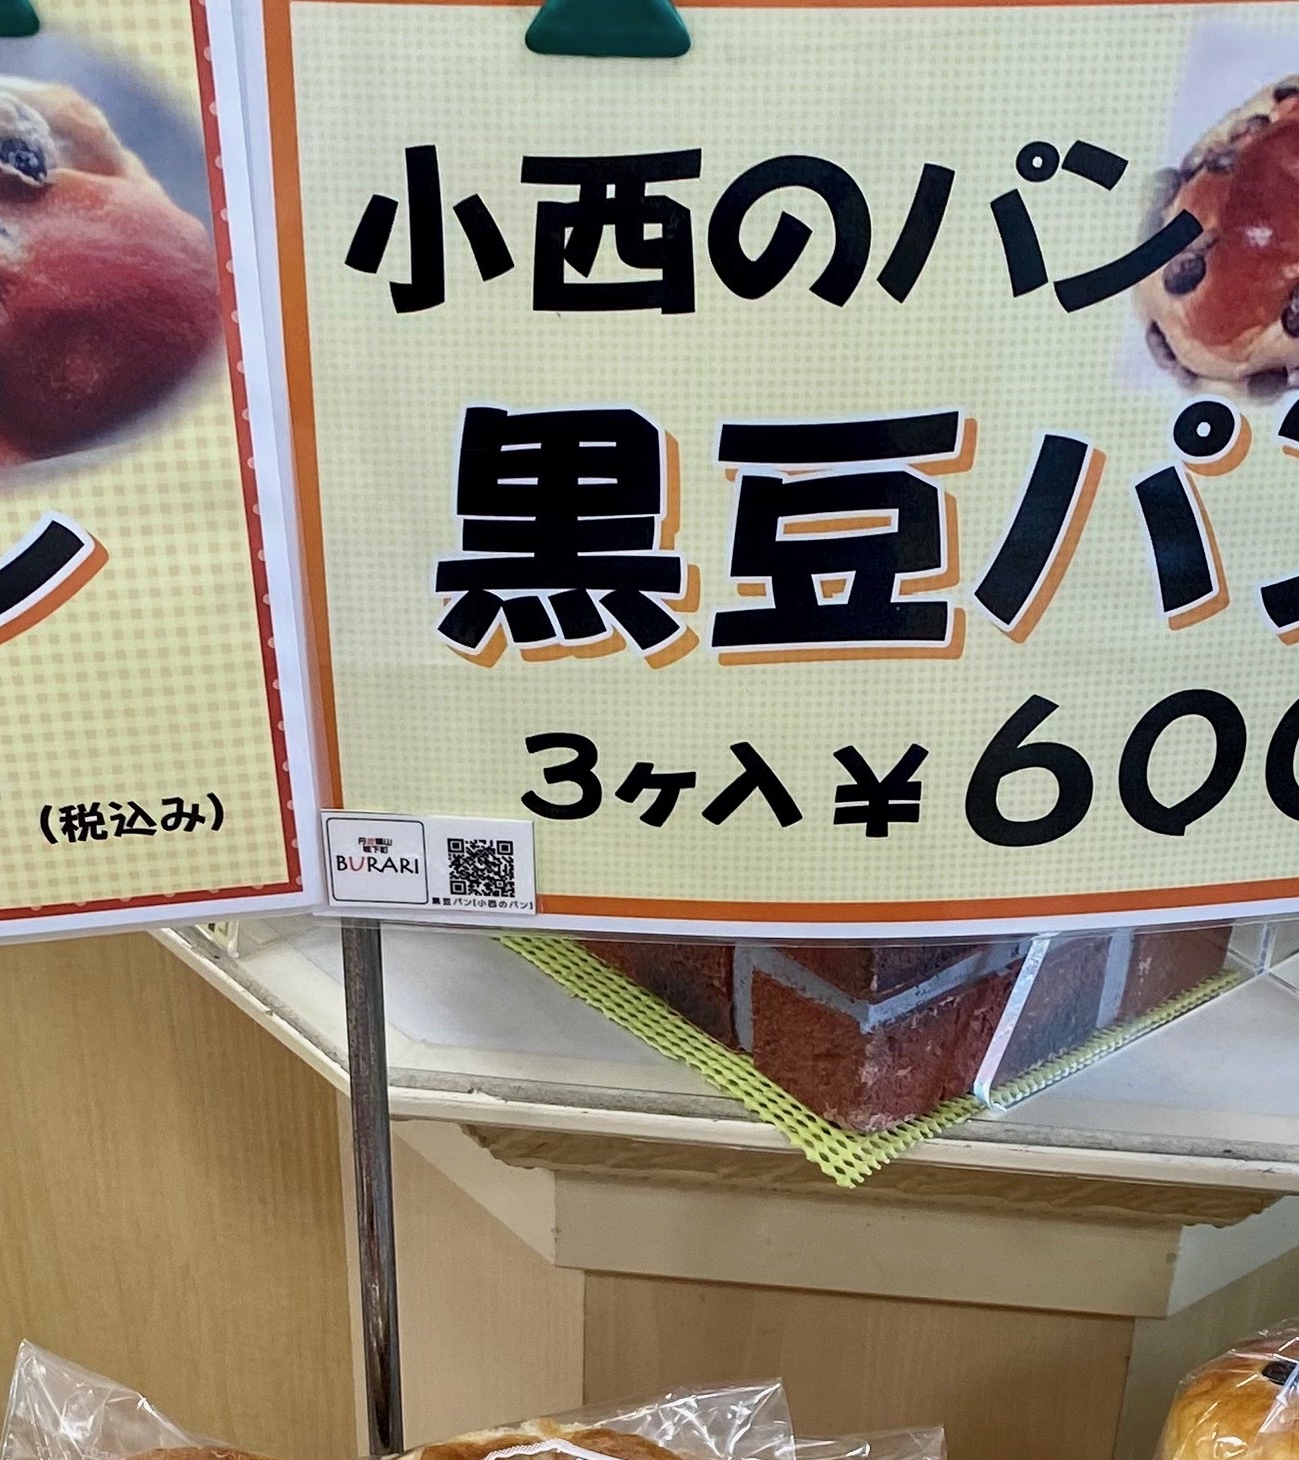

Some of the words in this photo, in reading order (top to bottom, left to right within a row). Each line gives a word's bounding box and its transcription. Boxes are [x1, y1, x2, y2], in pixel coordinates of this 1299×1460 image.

[345, 140, 1203, 313] 小西のパン
[38, 792, 226, 845] (税込み)
[336, 855, 420, 875] BURARI
